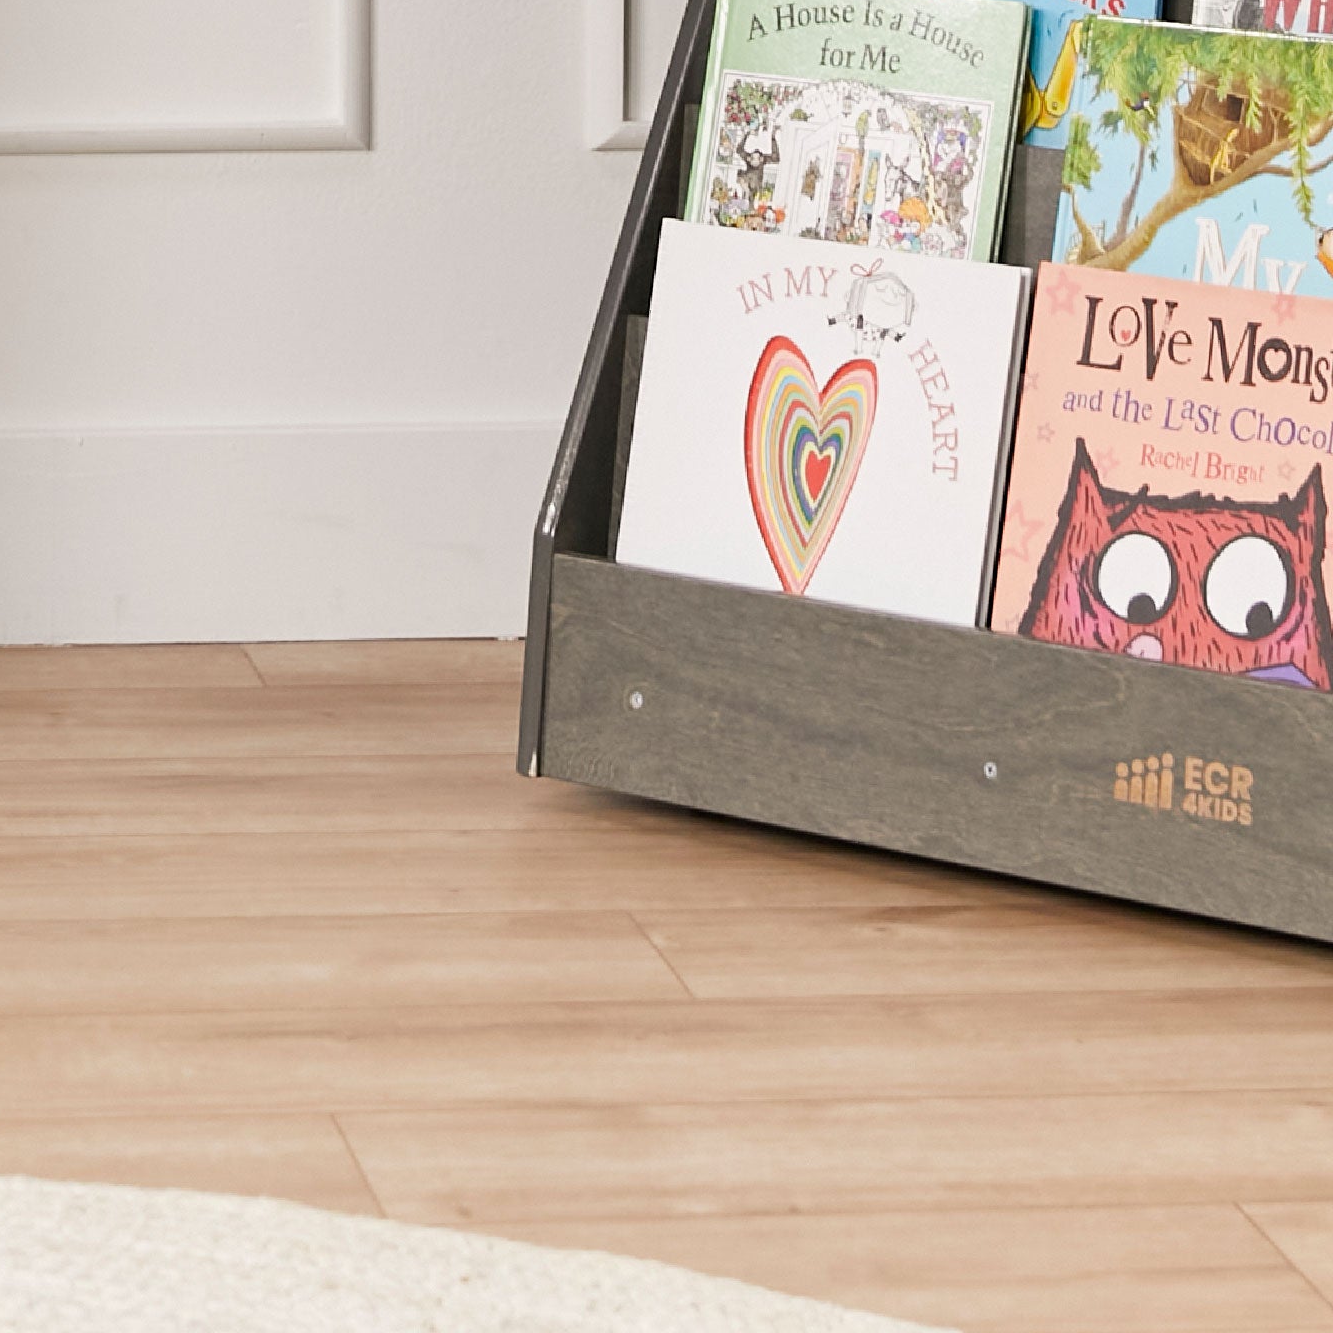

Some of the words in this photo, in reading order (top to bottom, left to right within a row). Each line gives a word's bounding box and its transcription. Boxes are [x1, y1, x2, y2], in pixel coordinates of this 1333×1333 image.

[748, 13, 768, 42] A
[774, 2, 855, 32] House
[890, 13, 904, 31] a
[909, 8, 985, 70] House
[819, 38, 856, 69] for
[860, 43, 901, 74] Me
[736, 272, 775, 314] IN
[784, 266, 837, 297] MY
[908, 337, 959, 481] HEART
[1062, 387, 1103, 412] and
[1112, 387, 1153, 423] the
[1140, 443, 1200, 478] Rachel
[1204, 452, 1266, 484] Bright
[1185, 756, 1254, 801] ECR
[1183, 792, 1254, 826] 4KIDS
